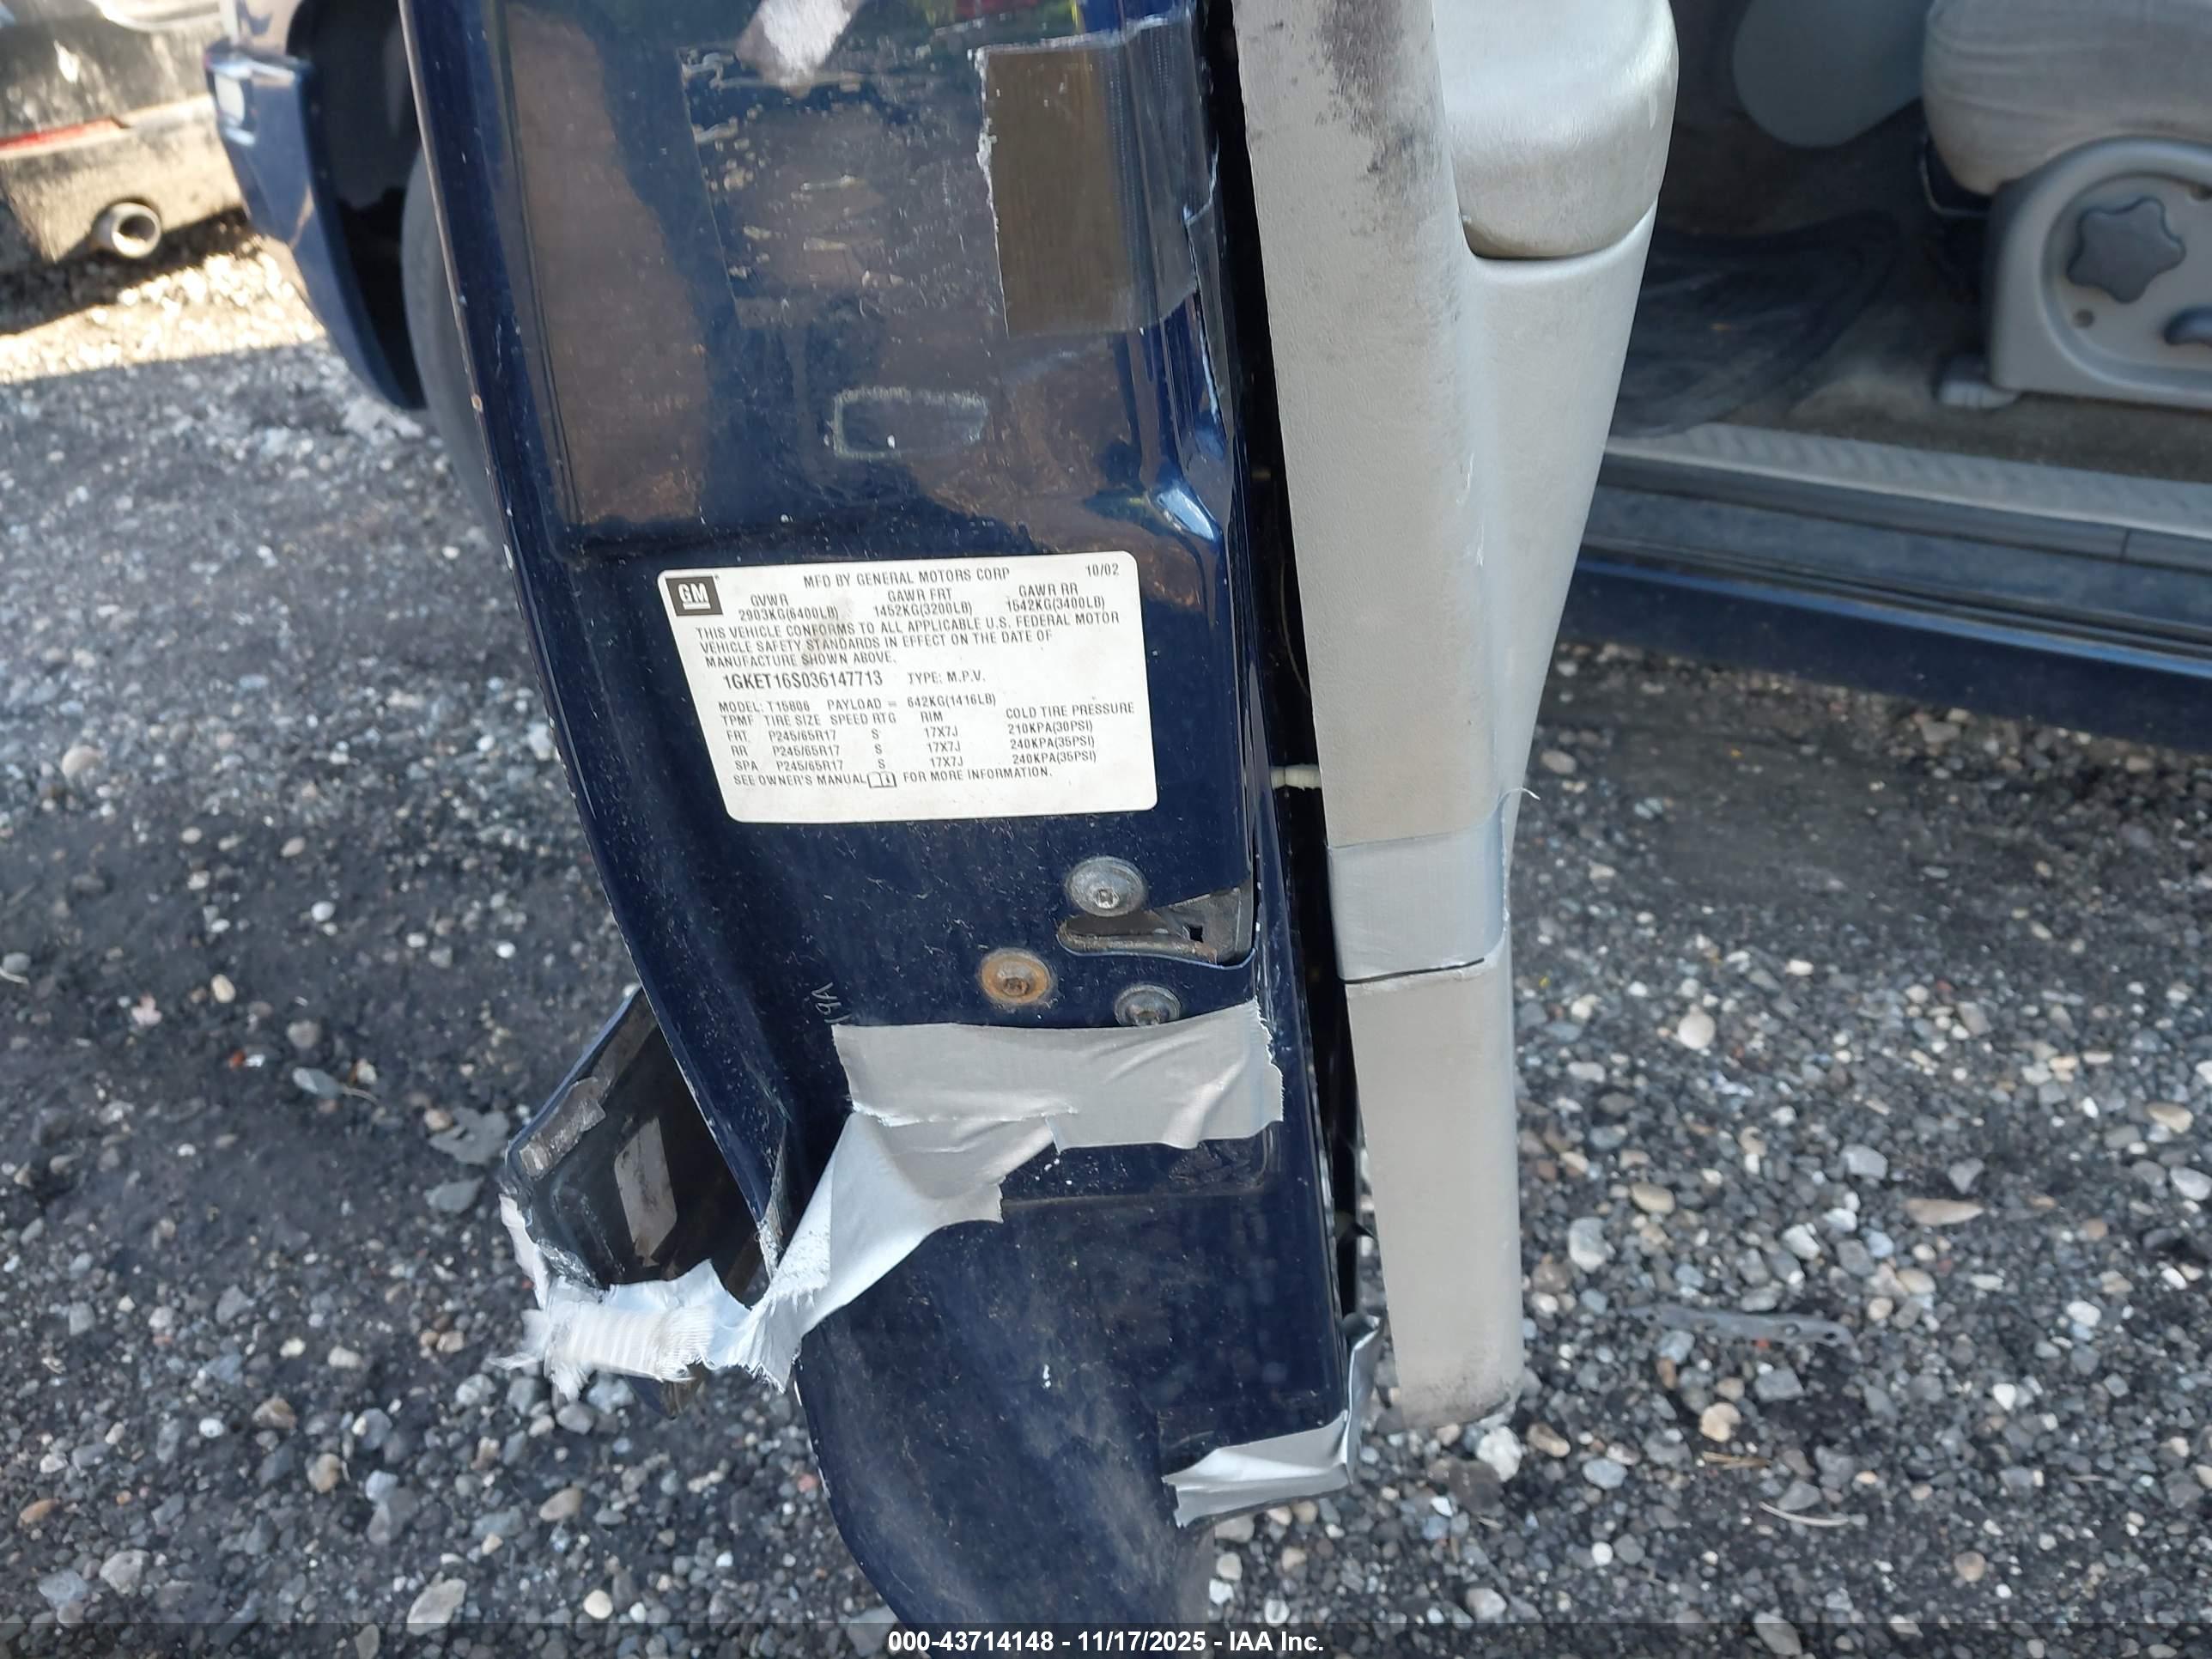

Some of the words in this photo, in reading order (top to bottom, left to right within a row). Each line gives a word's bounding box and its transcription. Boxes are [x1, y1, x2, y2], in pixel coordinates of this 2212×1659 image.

[804, 575, 830, 589] MFD
[836, 574, 851, 587] BY
[857, 570, 914, 586] GENERAL
[919, 568, 971, 582] MOTORS
[976, 568, 1010, 581] CORP
[1085, 563, 1120, 577] 10/02
[678, 583, 709, 604] GM
[888, 587, 926, 602] GAWR
[930, 587, 952, 600] FRT
[1019, 584, 1056, 597] GAWR
[1060, 582, 1079, 595] RR
[750, 593, 789, 606] GVWR
[1006, 596, 1105, 613] 1542KG(3400LB)
[738, 606, 839, 622] 2903KG(6400LB)
[873, 601, 973, 618] 1452KG(3200LB)
[696, 627, 726, 641] THIS
[729, 624, 781, 639] VEHICLE
[786, 622, 855, 637] CONFORMS
[860, 622, 875, 634] TO
[881, 620, 902, 634] ALL
[908, 617, 981, 633] APPLICABLE
[987, 616, 1011, 629] U.S.
[1016, 613, 1071, 629] FEDERAL
[1075, 611, 1120, 625] MOTOR
[700, 641, 753, 655] VEHICLE
[757, 639, 801, 653] SAFETY
[806, 635, 880, 652] STANDARDS
[884, 635, 898, 648] IN
[902, 634, 946, 649] EFFECT
[951, 633, 969, 646] ON
[973, 631, 996, 645] THE
[1002, 630, 1033, 644] DATE
[1036, 629, 1053, 641] OF
[706, 653, 798, 669] MANUFACTURE
[801, 651, 848, 666] SHOWN
[853, 650, 896, 665] ABOVE.
[723, 670, 883, 690] 1GKET16S036147713
[908, 671, 942, 685] TYPE:
[947, 670, 986, 684] M.P.V.
[718, 700, 763, 714] MODEL:
[768, 700, 811, 713] T15806
[827, 698, 882, 711] PAYLOAD
[907, 693, 996, 709] 642KG(1416LB)
[764, 714, 791, 726] TIRE
[795, 714, 821, 726] SIZE
[830, 712, 868, 726] SPEED
[872, 712, 896, 724] RTG
[921, 711, 943, 723] RIM
[1006, 706, 1036, 720] COLD
[1041, 705, 1067, 718] TIRE
[1072, 702, 1134, 716] PRESSURE
[726, 729, 748, 743] FRT
[768, 728, 836, 742] P245/65R17
[872, 728, 879, 739] S
[924, 726, 958, 738] 17X7J
[1008, 720, 1093, 735] 210KPA(30PSI)
[731, 745, 748, 757] RR
[772, 744, 840, 757] P245/65R17
[874, 744, 883, 755] S
[927, 740, 961, 753] 17X7J
[1010, 735, 1095, 750] 240KPA(35PSI)
[734, 760, 759, 771] SPA
[776, 759, 843, 772] P245/65R17
[878, 758, 886, 769] S
[930, 756, 963, 768] 17X7J
[1012, 750, 1097, 765] 240KPA(35PSI)
[732, 775, 755, 786] SEE
[758, 774, 813, 786] OWNER'S
[817, 772, 866, 786] MANUAL
[903, 771, 927, 783] FOR
[930, 769, 963, 782] MORE
[968, 766, 1052, 781] INFORMATION.
